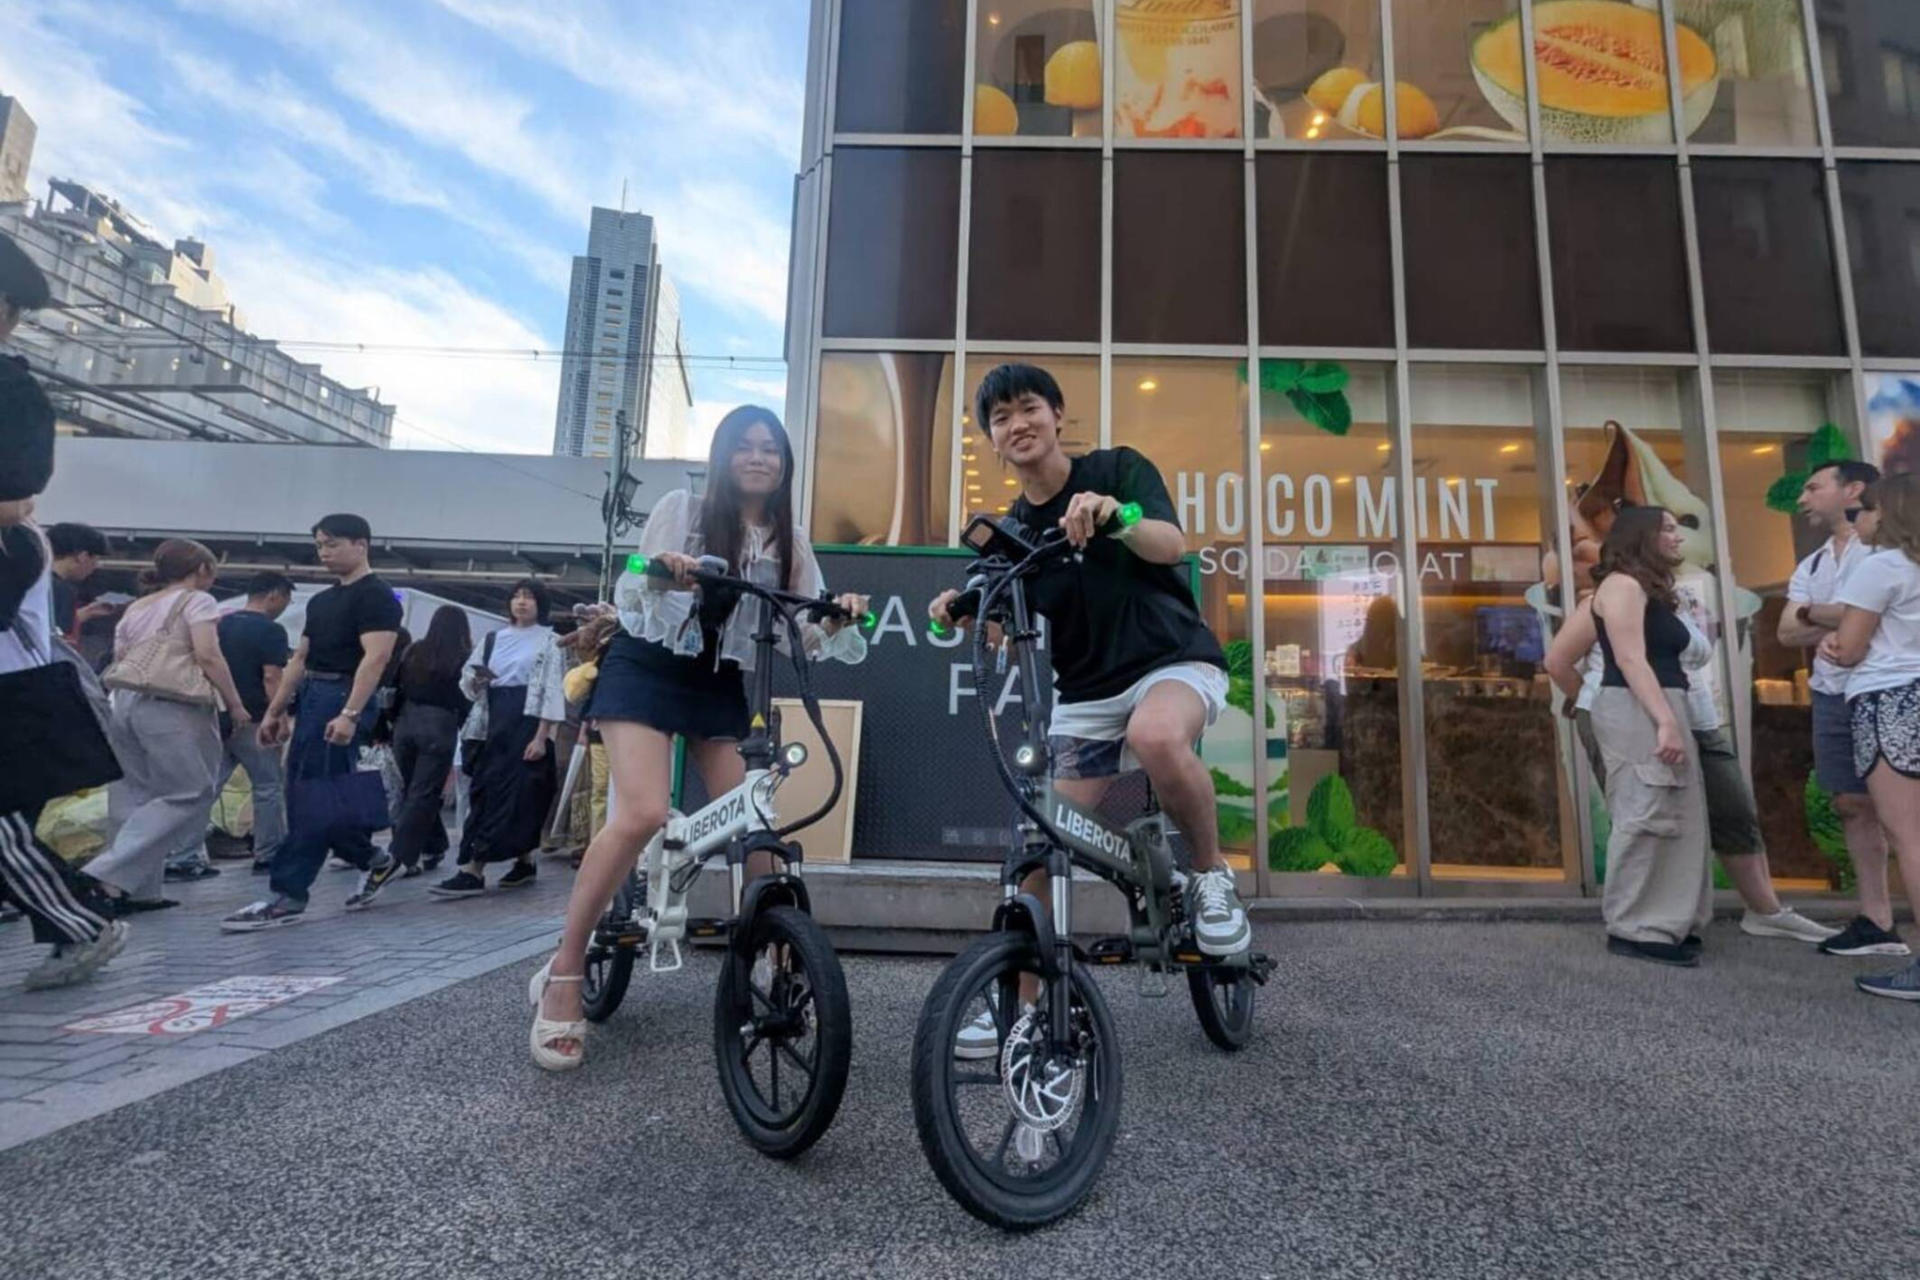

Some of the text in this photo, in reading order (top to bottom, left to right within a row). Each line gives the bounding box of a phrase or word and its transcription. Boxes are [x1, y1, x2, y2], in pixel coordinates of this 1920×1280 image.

[1177, 472, 1498, 541] HOCO MINT
[683, 794, 745, 844] LIBEROTA
[1056, 804, 1131, 863] LIBEROTA
